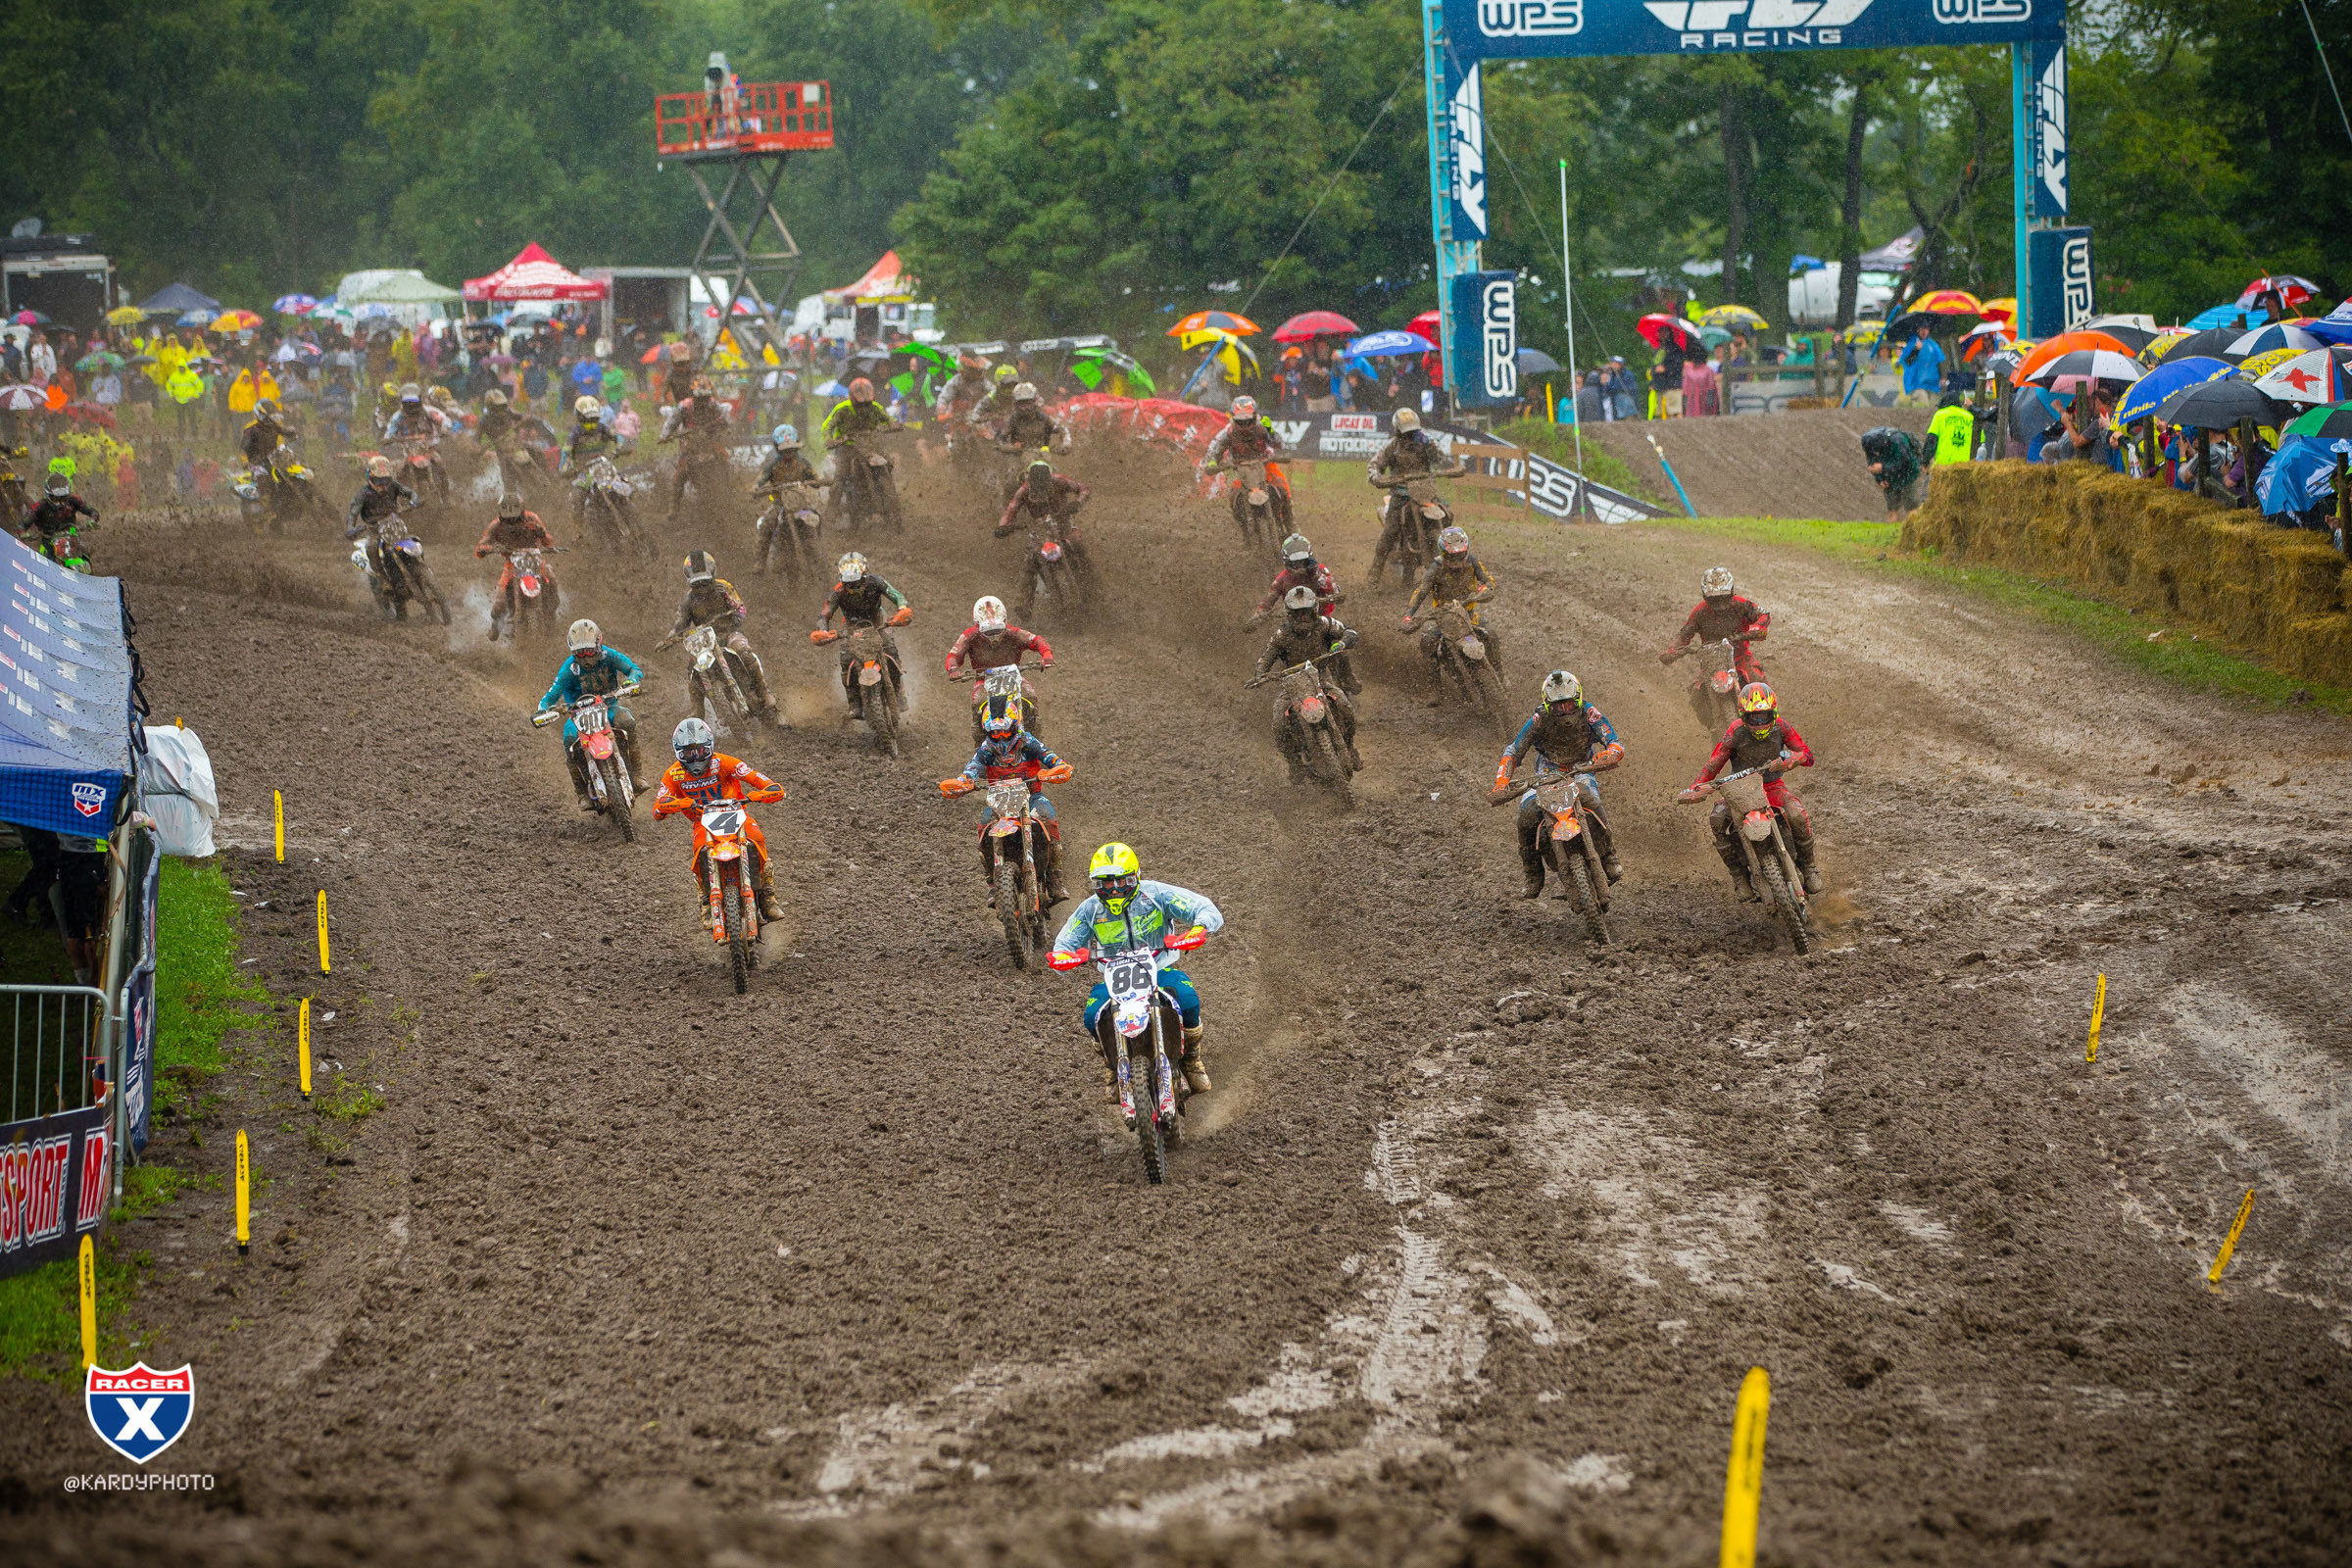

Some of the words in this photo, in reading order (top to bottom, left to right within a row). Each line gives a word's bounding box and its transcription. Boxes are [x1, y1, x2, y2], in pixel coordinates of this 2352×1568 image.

[1681, 28, 1841, 49] RACING
[1448, 100, 1460, 201] RACING
[1454, 61, 1487, 236] FLY
[2034, 80, 2044, 178] RACING
[2042, 44, 2067, 213] FLY
[2063, 237, 2093, 331] WP
[1483, 280, 1517, 398] WPS
[1271, 420, 1311, 444] LY
[1334, 416, 1360, 429] LUCAS
[1362, 417, 1374, 429] OIL
[708, 811, 740, 835] 4
[1112, 961, 1152, 996] 86
